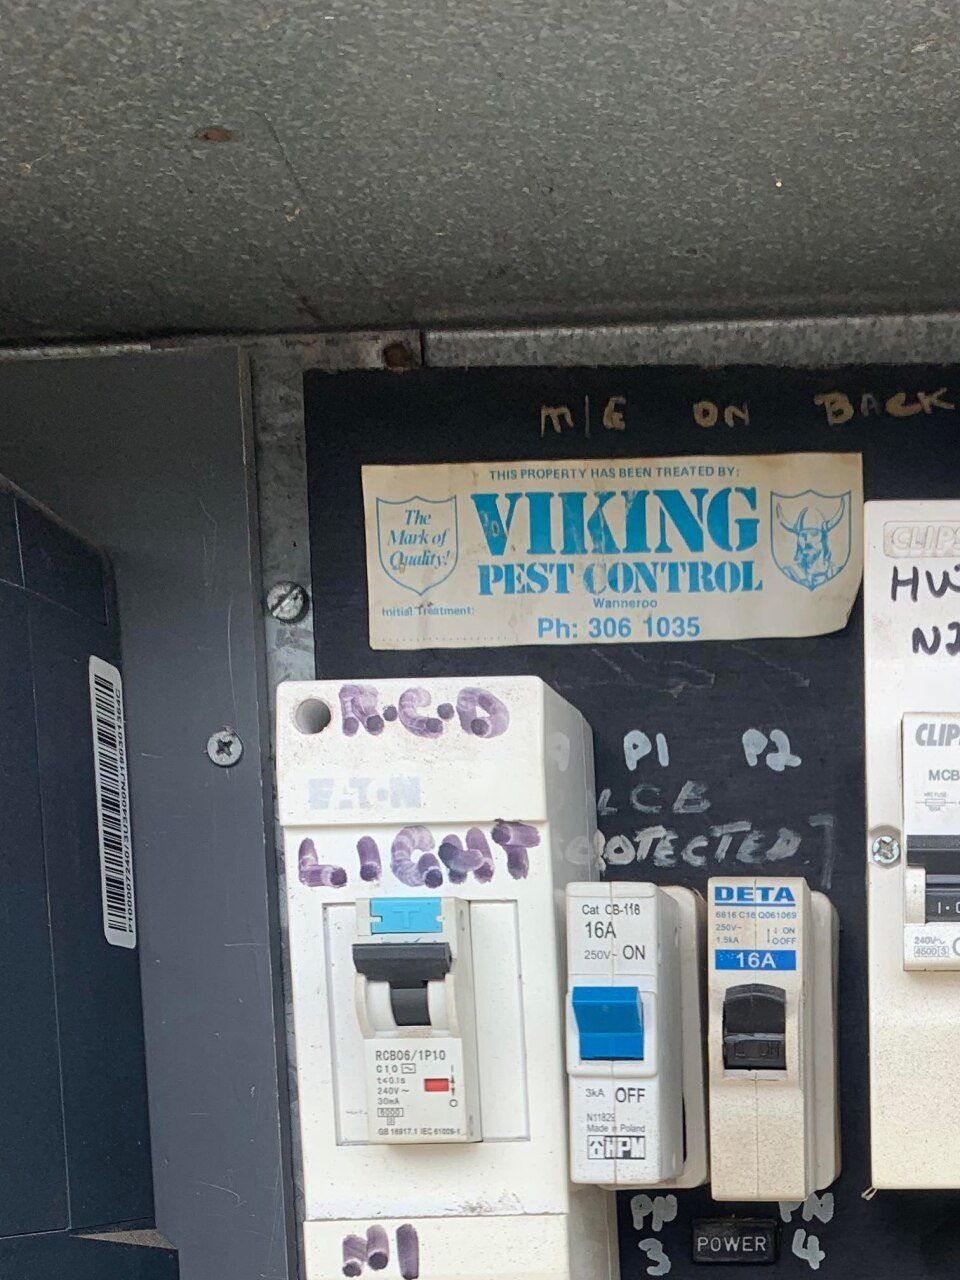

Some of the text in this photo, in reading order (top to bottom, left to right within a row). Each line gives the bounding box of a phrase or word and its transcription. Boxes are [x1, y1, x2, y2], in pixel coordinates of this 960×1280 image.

[693, 401, 750, 429] ON
[814, 387, 955, 425] BACK
[490, 465, 740, 481] THIS PROPERTY HAS BEEN TREATED BY:
[404, 509, 432, 526] The
[470, 487, 760, 556] VIKING
[387, 528, 449, 547] Mark of
[389, 549, 452, 570] Quality!
[477, 561, 763, 596] PEST CONTROL
[382, 605, 474, 617] Initial Treatment:
[593, 598, 658, 610] Wanneroo
[538, 617, 700, 639] Ph: 306 1035
[623, 728, 669, 771] P1
[742, 728, 801, 771] P2
[714, 886, 795, 902] DETA
[581, 902, 641, 916] Cat CB-116
[585, 921, 617, 939] 16A
[783, 927, 795, 935] ON
[623, 945, 645, 960] ON
[736, 952, 777, 968] 16A
[915, 947, 938, 956] 4500
[585, 1087, 646, 1103] 3kA OFF
[586, 1123, 646, 1133] Made Poland
[605, 1135, 645, 1160] HPM
[697, 1236, 767, 1252] POWER
[792, 1229, 826, 1270] 4
[638, 1238, 671, 1276] 3
